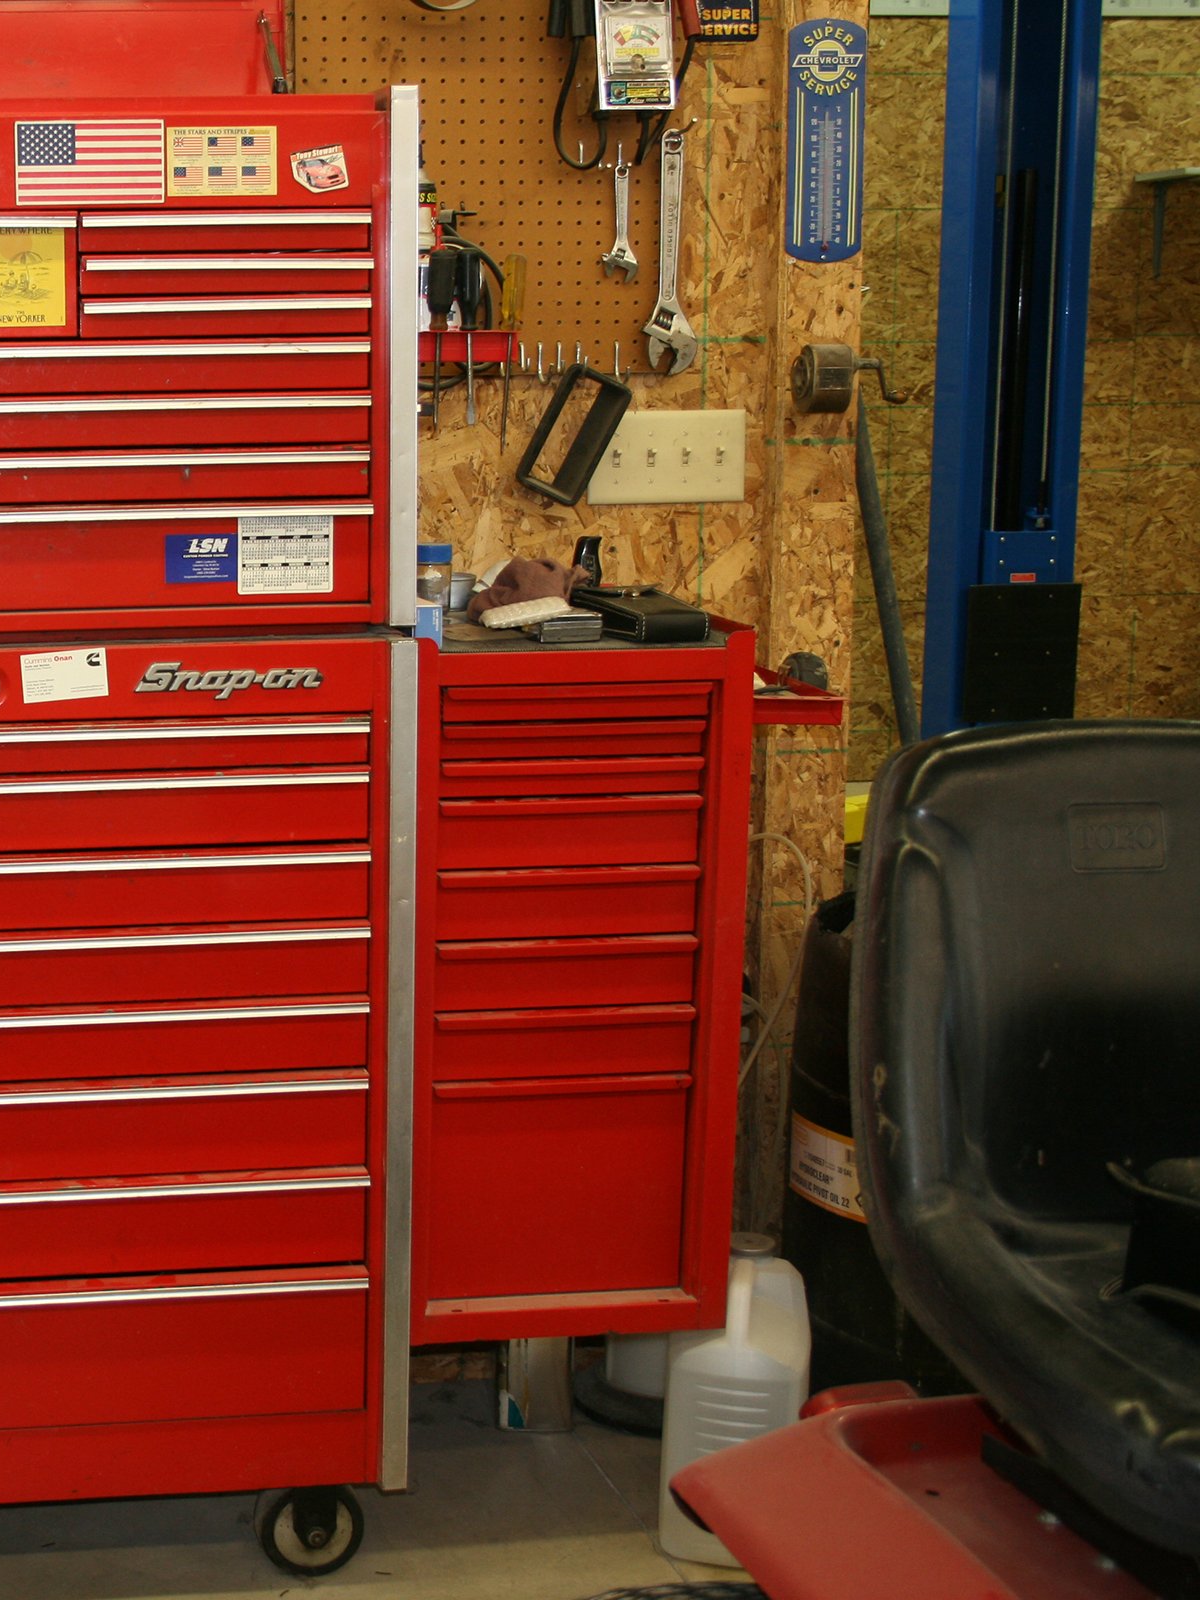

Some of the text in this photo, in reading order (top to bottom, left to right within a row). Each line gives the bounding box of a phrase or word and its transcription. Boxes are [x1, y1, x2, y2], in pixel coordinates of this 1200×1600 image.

[703, 9, 750, 20] SUPER
[803, 26, 853, 47] SUPER
[799, 70, 857, 96] SERVICE
[296, 146, 338, 160] Tony Stewart
[16, 315, 45, 323] YORKER
[188, 538, 228, 553] LSN
[24, 657, 53, 665] Cummins
[134, 662, 322, 700] Snap-on
[1075, 822, 1154, 850] TORO
[841, 1196, 850, 1209] 22
